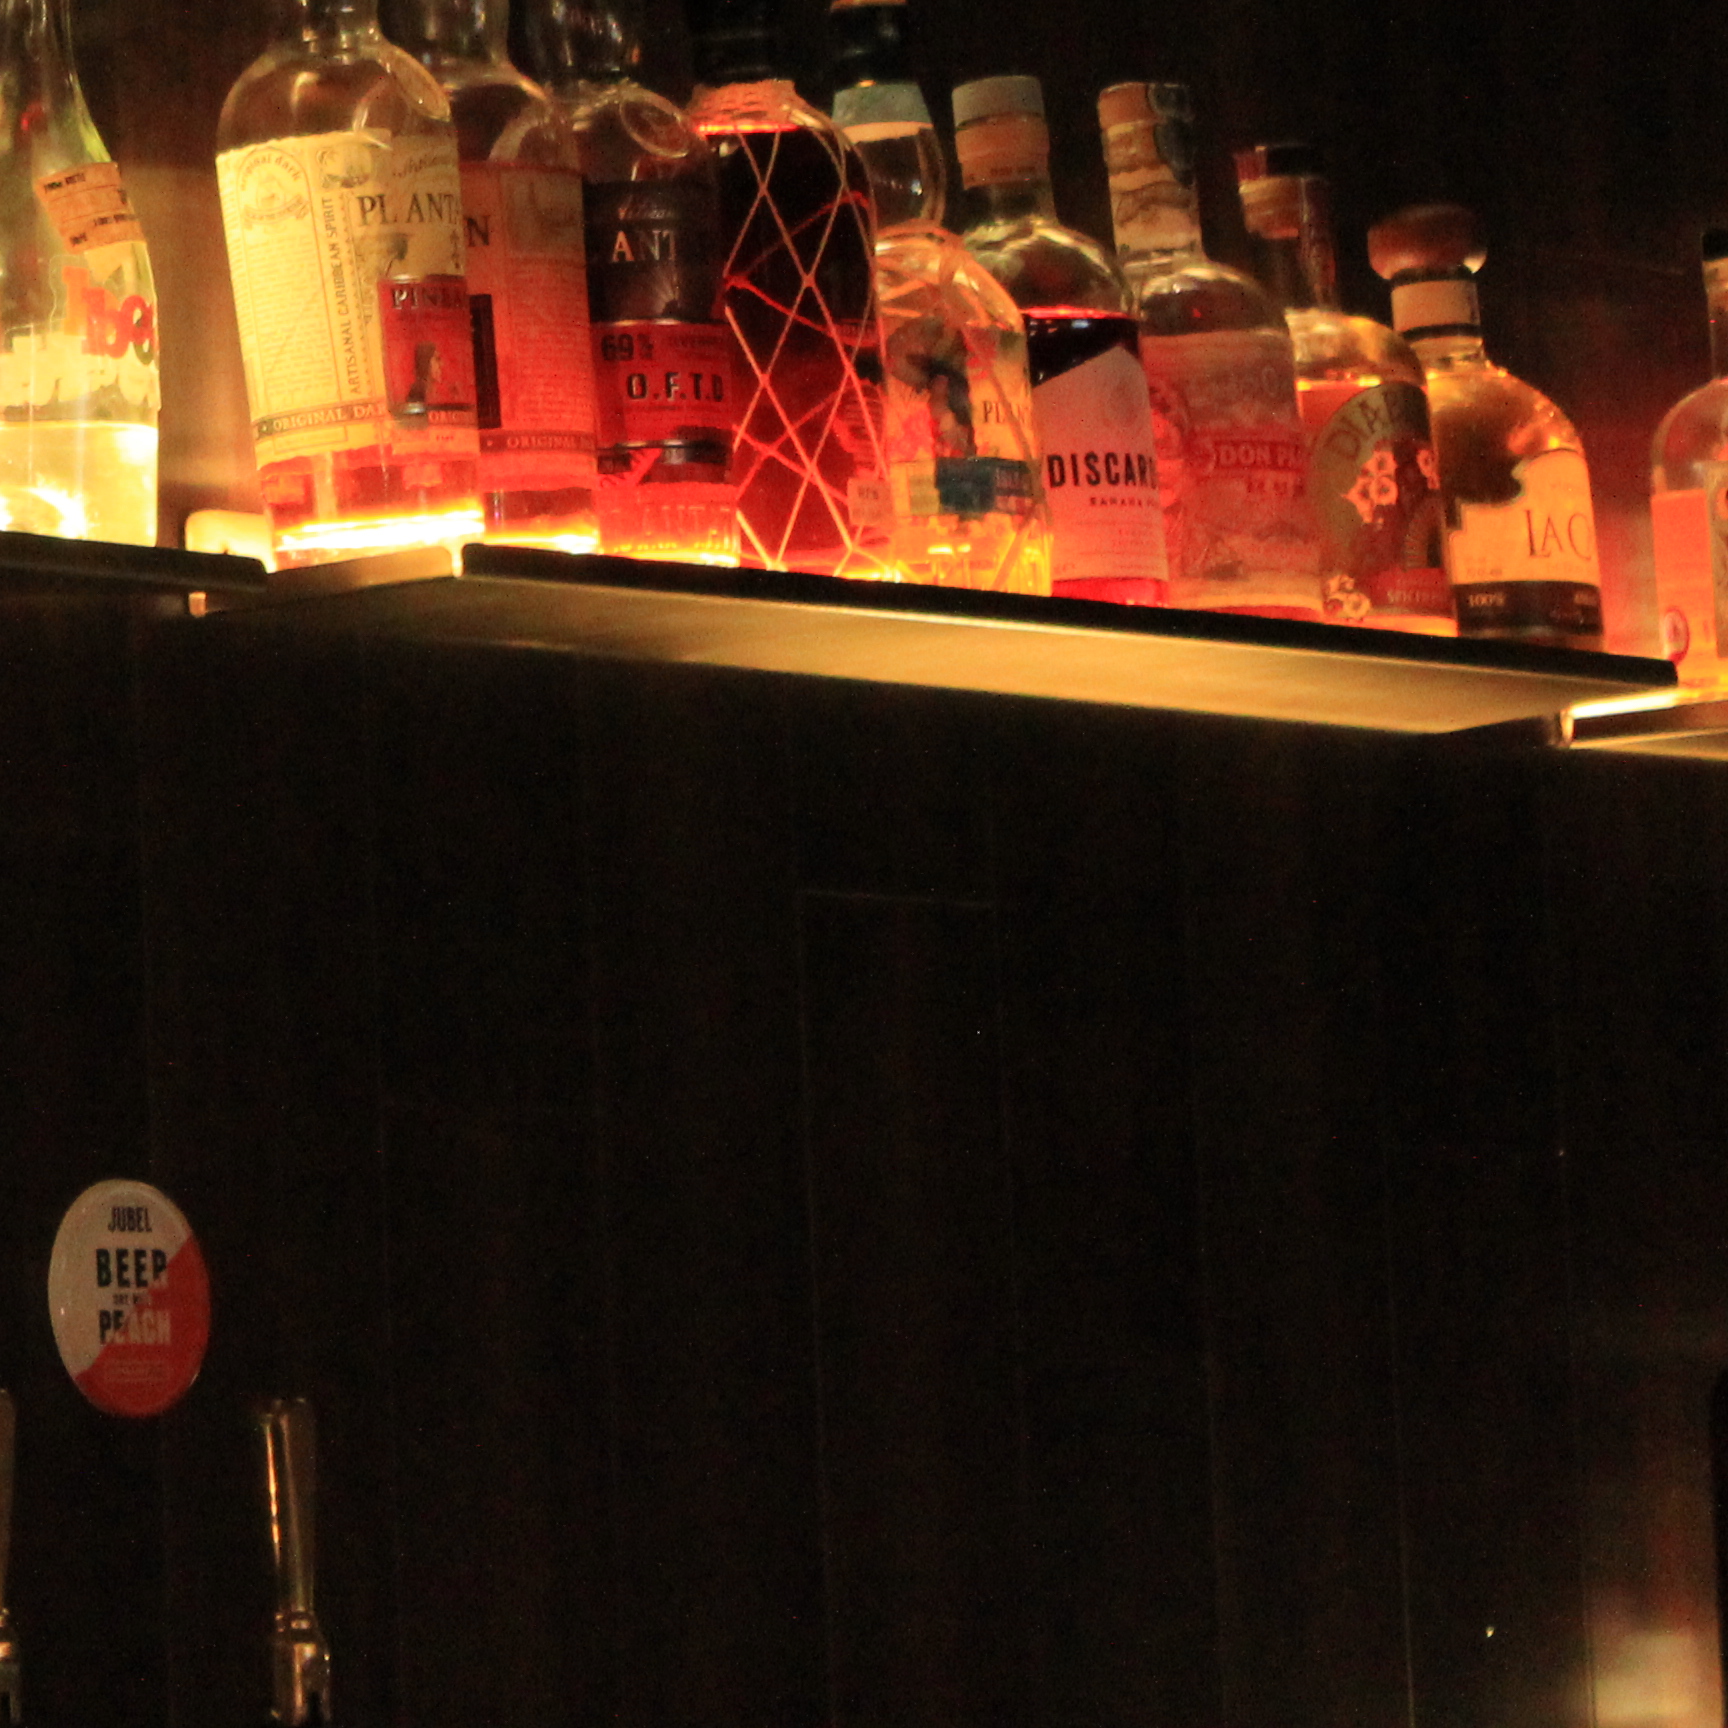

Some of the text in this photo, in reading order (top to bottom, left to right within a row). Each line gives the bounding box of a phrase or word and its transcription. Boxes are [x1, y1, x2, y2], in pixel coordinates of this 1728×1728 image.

[321, 197, 360, 394] ARTISANAL CARIBBEAN SPIRIT
[272, 405, 347, 432] ORIGINAL
[1219, 443, 1274, 468] DON
[108, 1207, 153, 1233] JUBEL
[96, 1248, 168, 1289] BEER
[99, 1309, 172, 1346] PEACH
